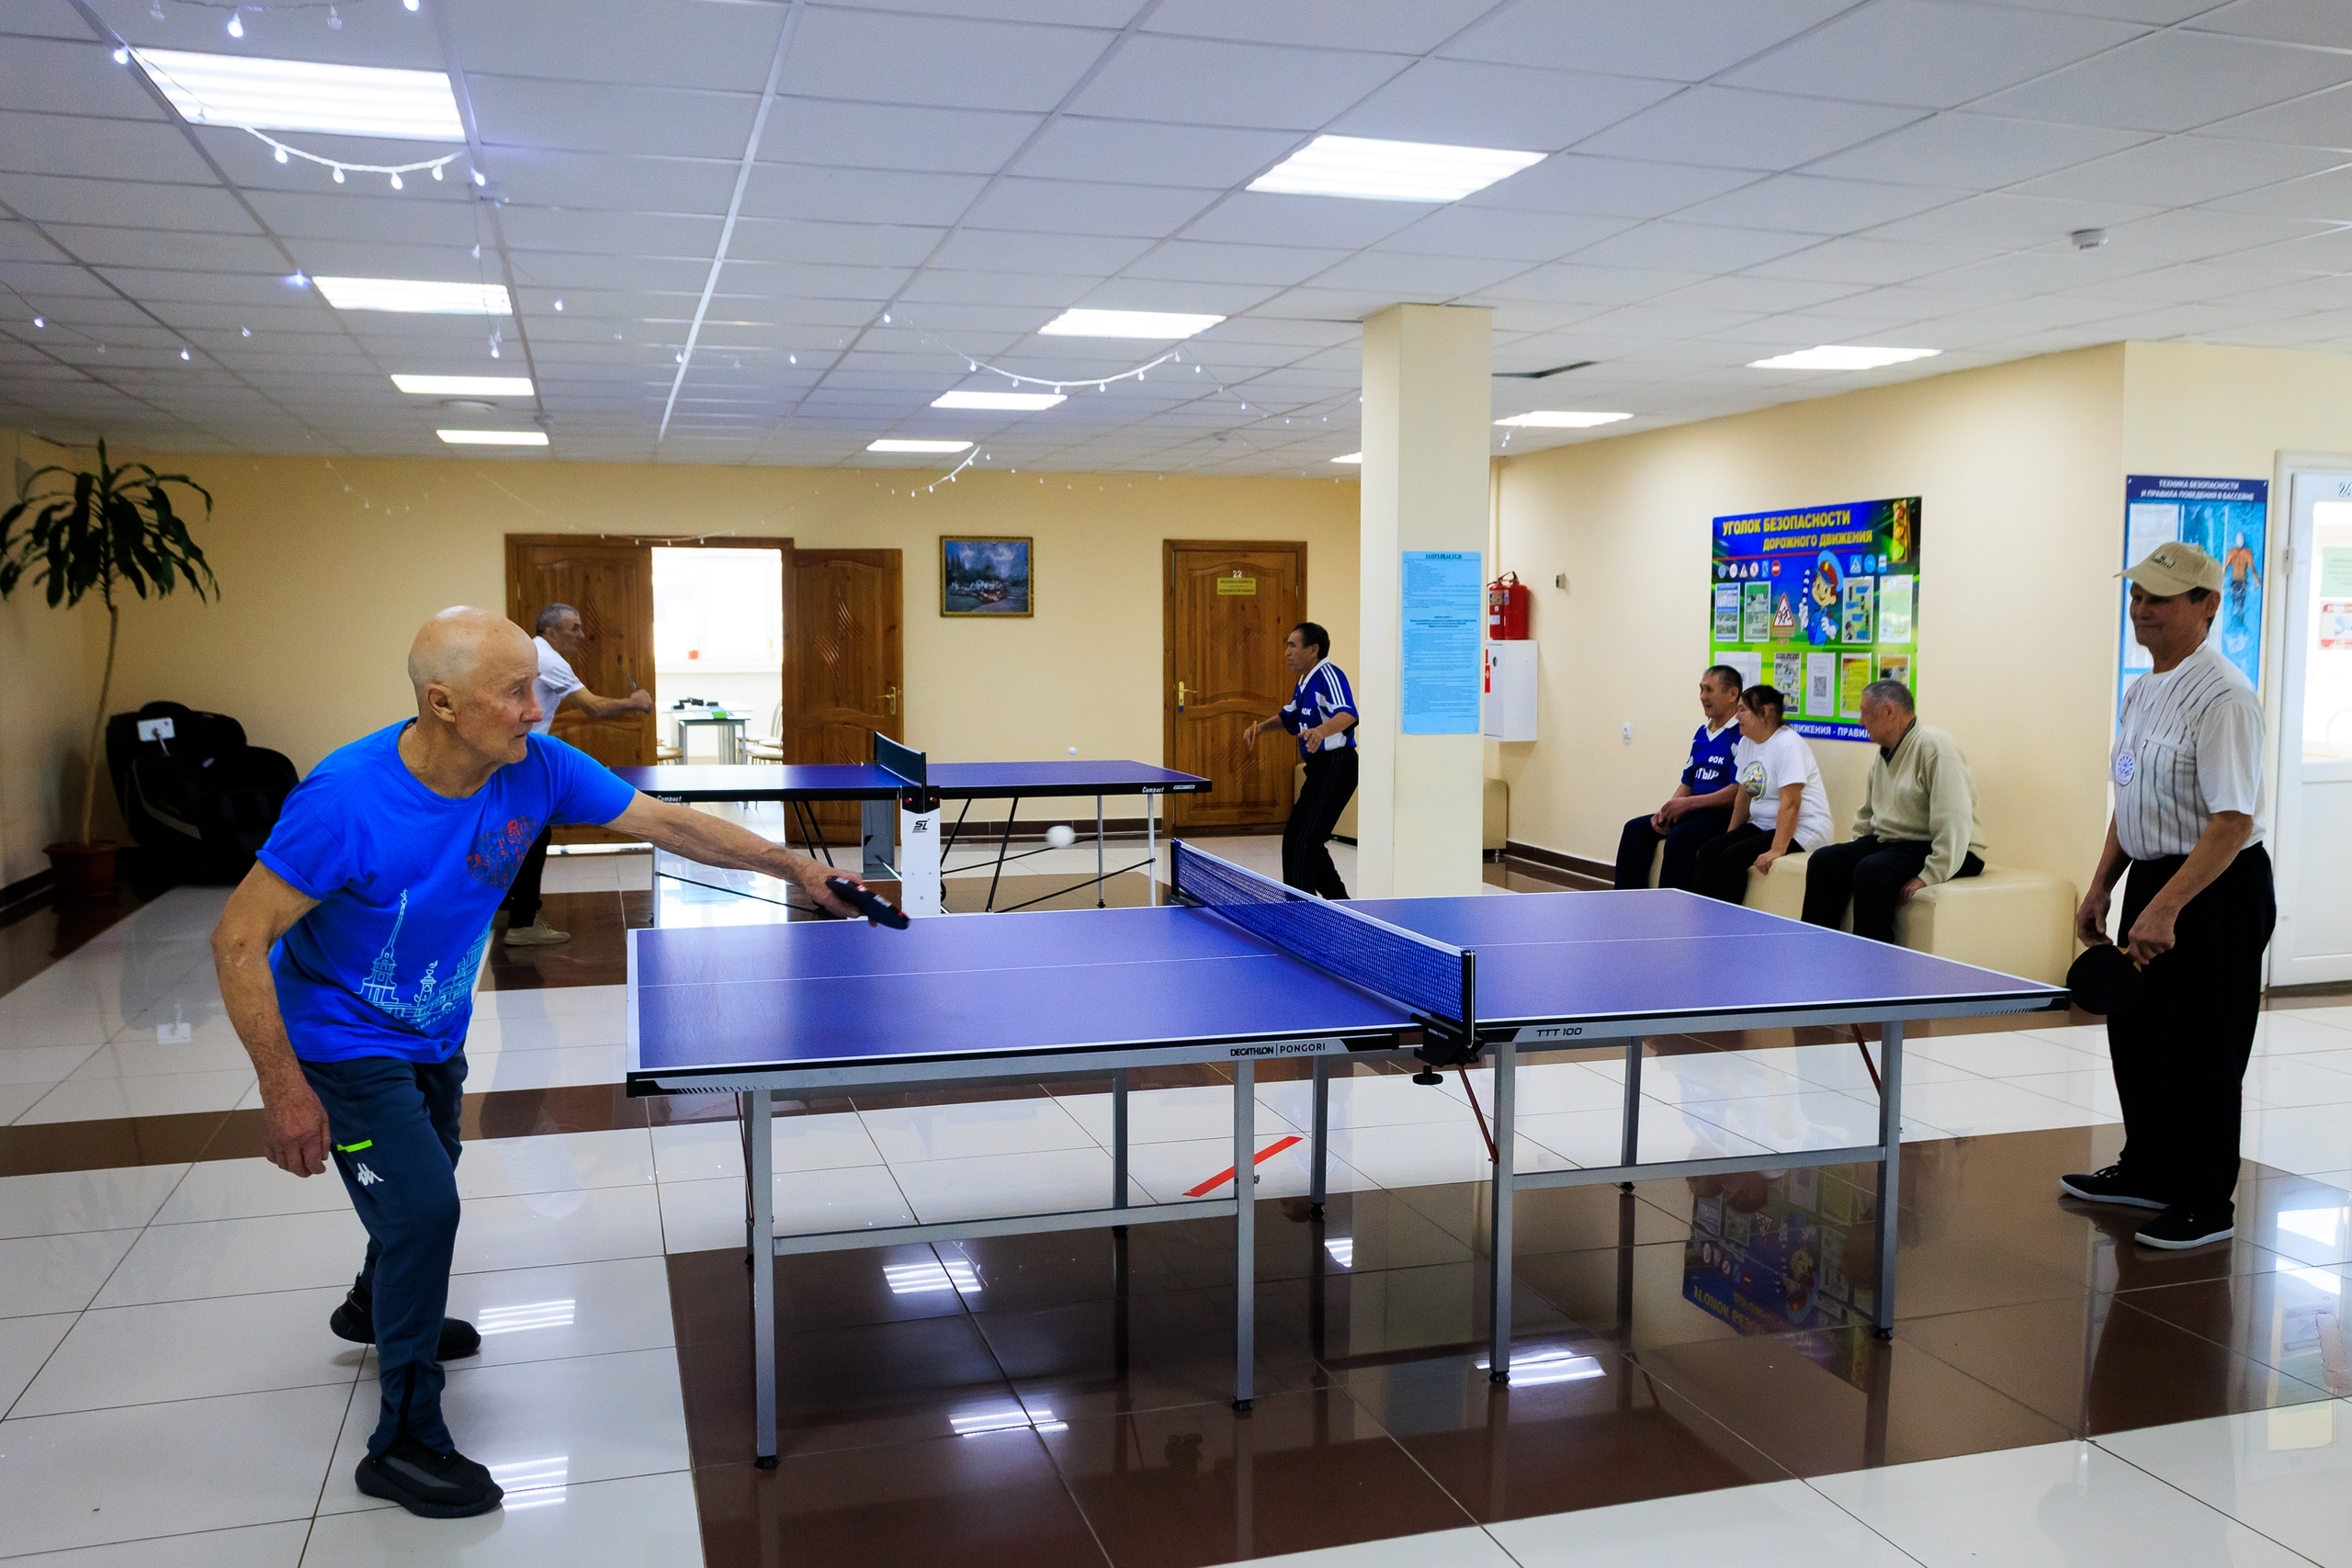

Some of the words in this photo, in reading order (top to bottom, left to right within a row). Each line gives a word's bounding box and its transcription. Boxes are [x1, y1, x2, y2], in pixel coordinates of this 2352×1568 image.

[1723, 519, 1760, 536] УГОЛОК
[1763, 510, 1850, 532] БЕЗОПАСНОСТИ
[1763, 536, 1817, 551] ДОРОЖНОГО
[1819, 530, 1872, 547] ДВИЖЕНИЯ
[1233, 570, 1242, 579] 22
[1708, 755, 1724, 764] ФОК
[1695, 767, 1719, 780] ТЫР
[1536, 1029, 1561, 1037] TTT
[1563, 1027, 1582, 1036] 100
[1230, 1046, 1274, 1056] DECATHLON
[1280, 1043, 1326, 1054] PONGORI
